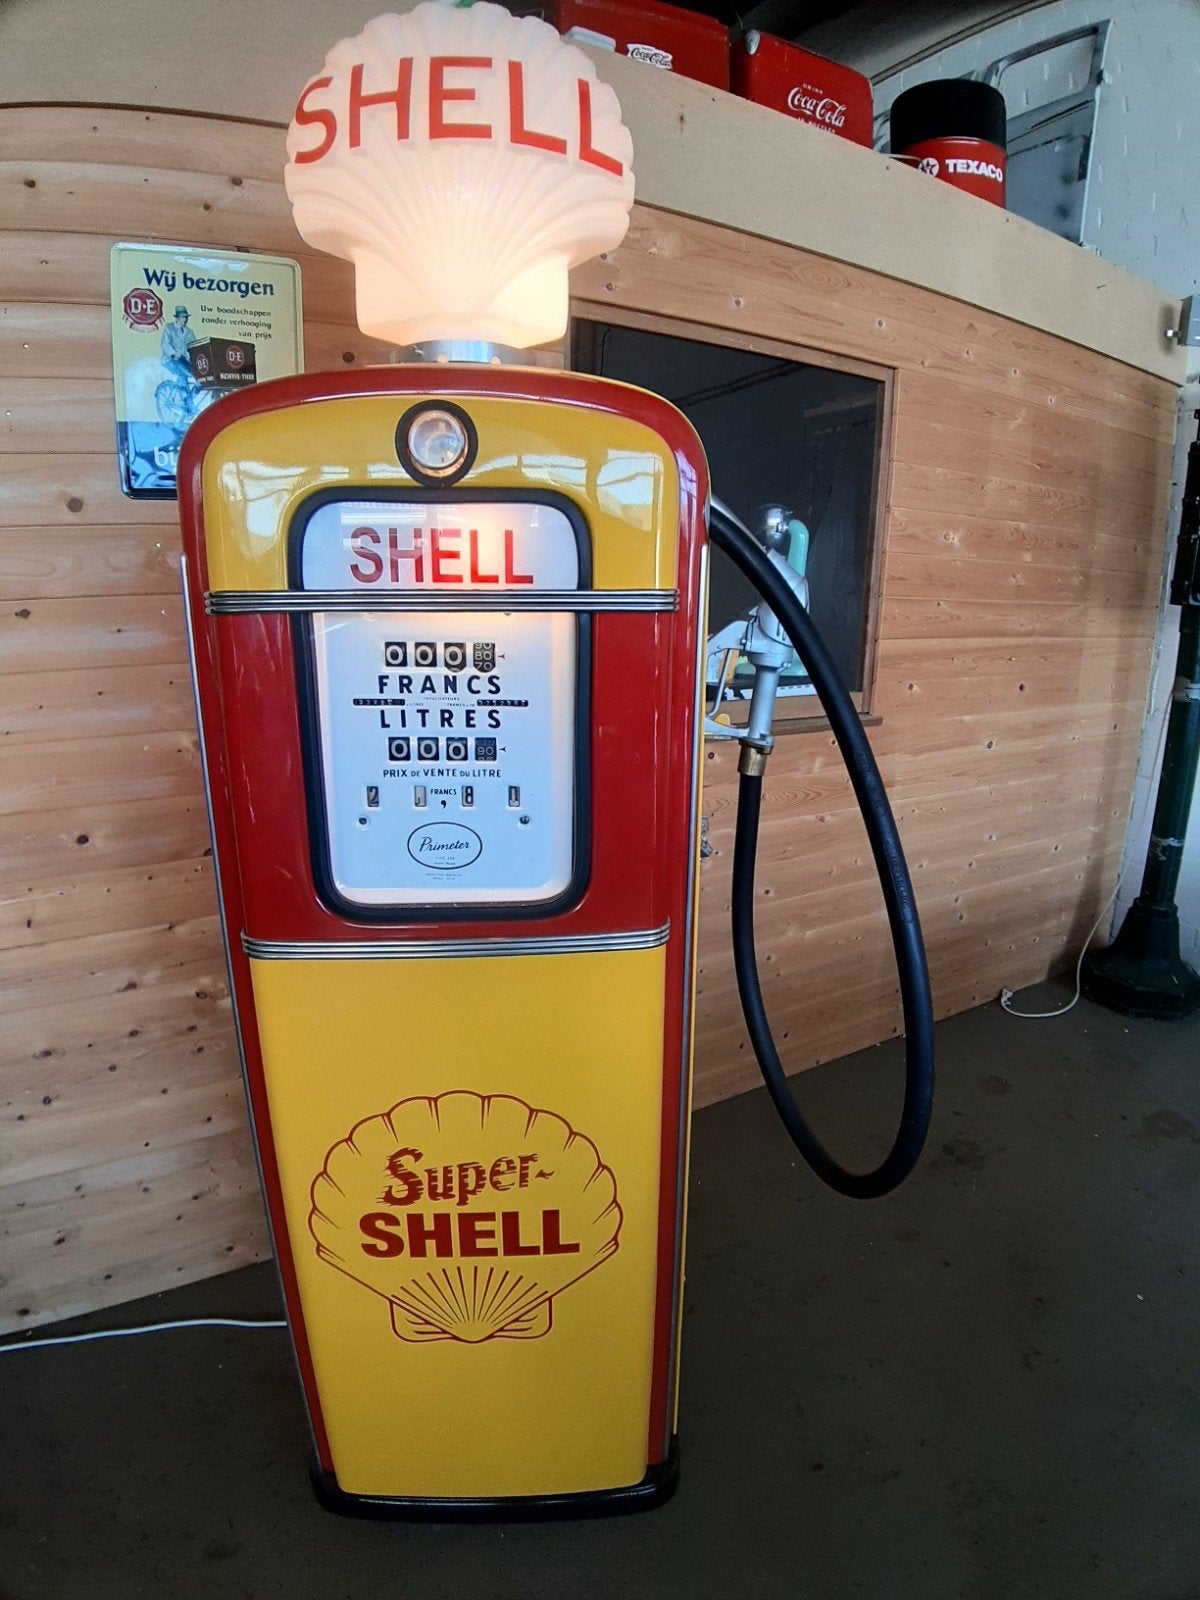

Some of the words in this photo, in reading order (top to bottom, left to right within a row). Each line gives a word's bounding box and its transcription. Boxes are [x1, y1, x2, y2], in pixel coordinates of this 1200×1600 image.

[787, 87, 847, 127] Coca-Cola
[293, 56, 623, 178] SHELL
[945, 158, 1003, 182] TEXACO
[143, 267, 176, 292] Wij
[182, 272, 274, 298] bezorgen
[200, 304, 214, 312] Uw
[217, 306, 271, 317] boodschappen
[201, 317, 228, 325] zonder
[229, 319, 272, 330] verhooging
[255, 331, 272, 340] prijs
[350, 526, 534, 584] SHELL
[474, 651, 492, 661] 80
[377, 674, 502, 695] FRANCS
[380, 709, 502, 729] LITRES
[477, 746, 494, 756] 90
[383, 769, 408, 778] PRIX
[423, 768, 457, 778] VENTE
[472, 768, 502, 778] LITRE
[430, 788, 457, 796] FRANCS
[419, 836, 470, 852] Primeter
[358, 1208, 581, 1259] SHELL
